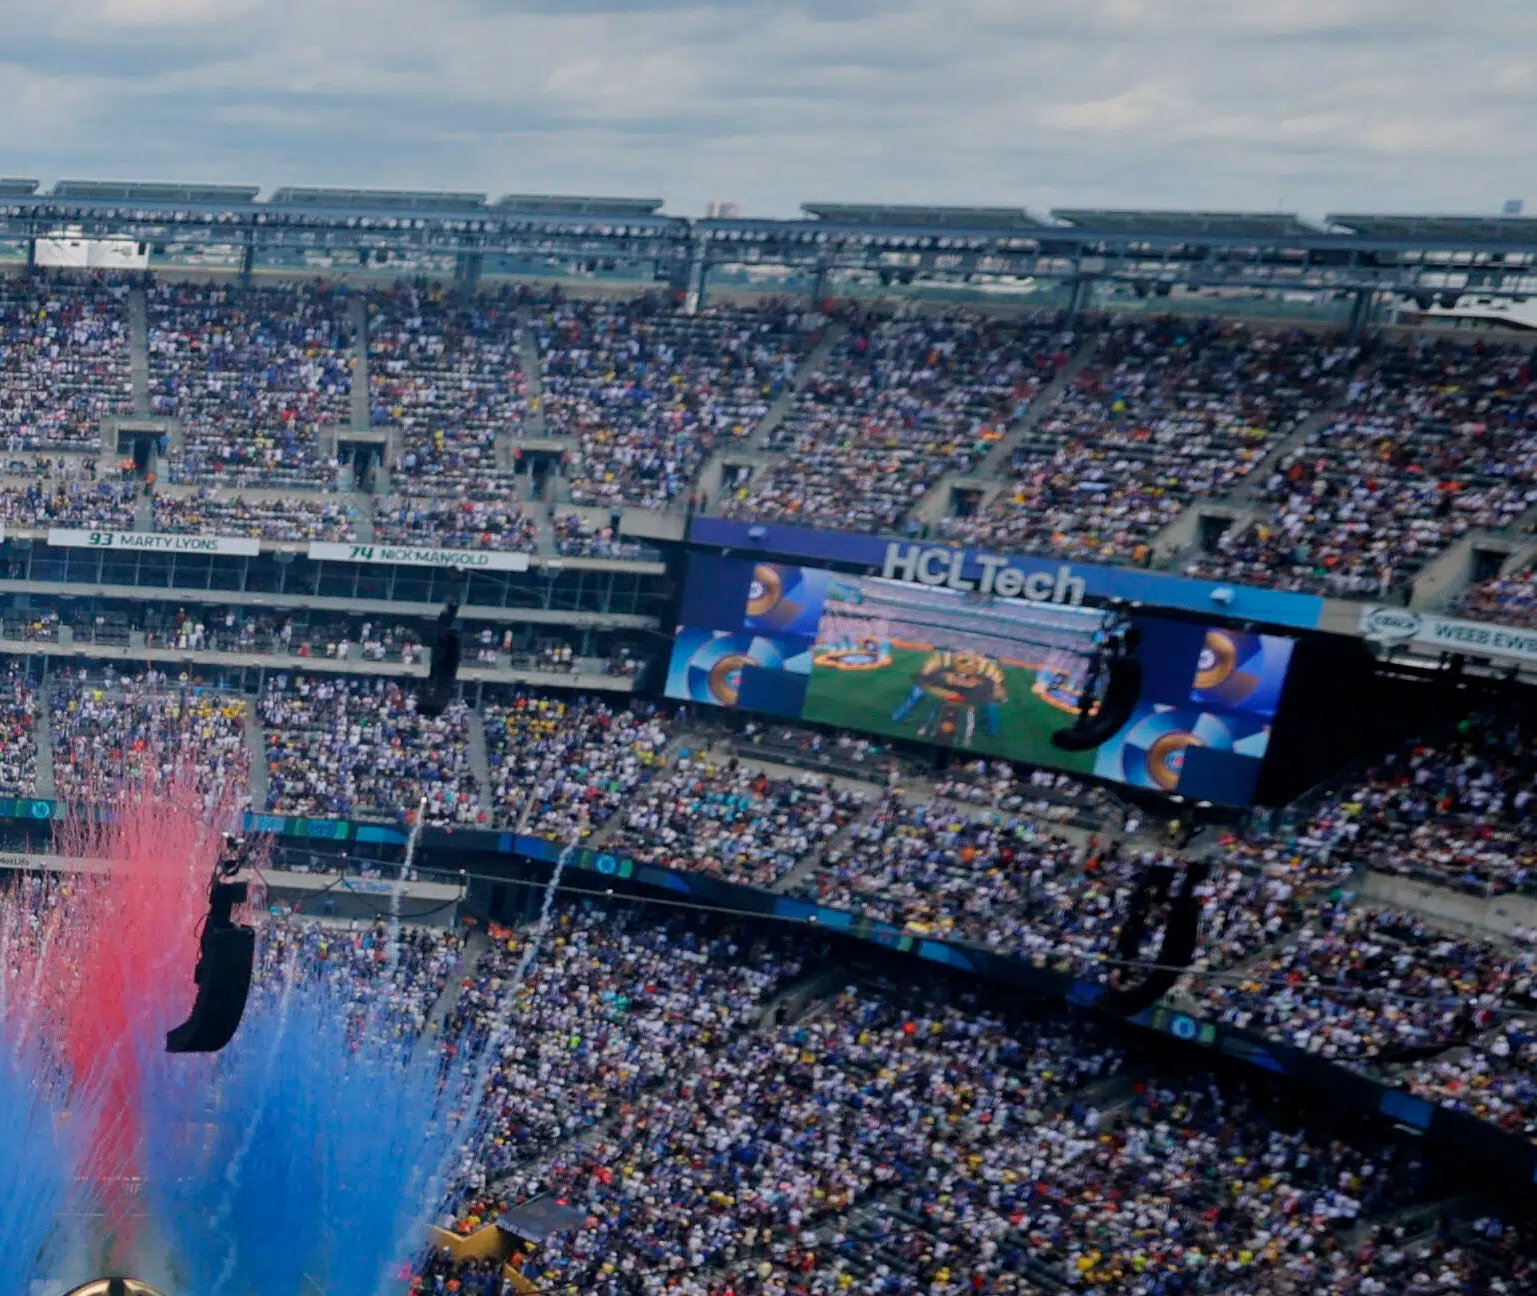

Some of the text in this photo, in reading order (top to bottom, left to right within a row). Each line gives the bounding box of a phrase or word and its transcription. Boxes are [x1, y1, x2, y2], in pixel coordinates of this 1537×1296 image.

[88, 533, 218, 550] 93 MARTY LYONS
[349, 546, 489, 565] 74 NICK MANGOLD
[881, 543, 1086, 605] HCLTech
